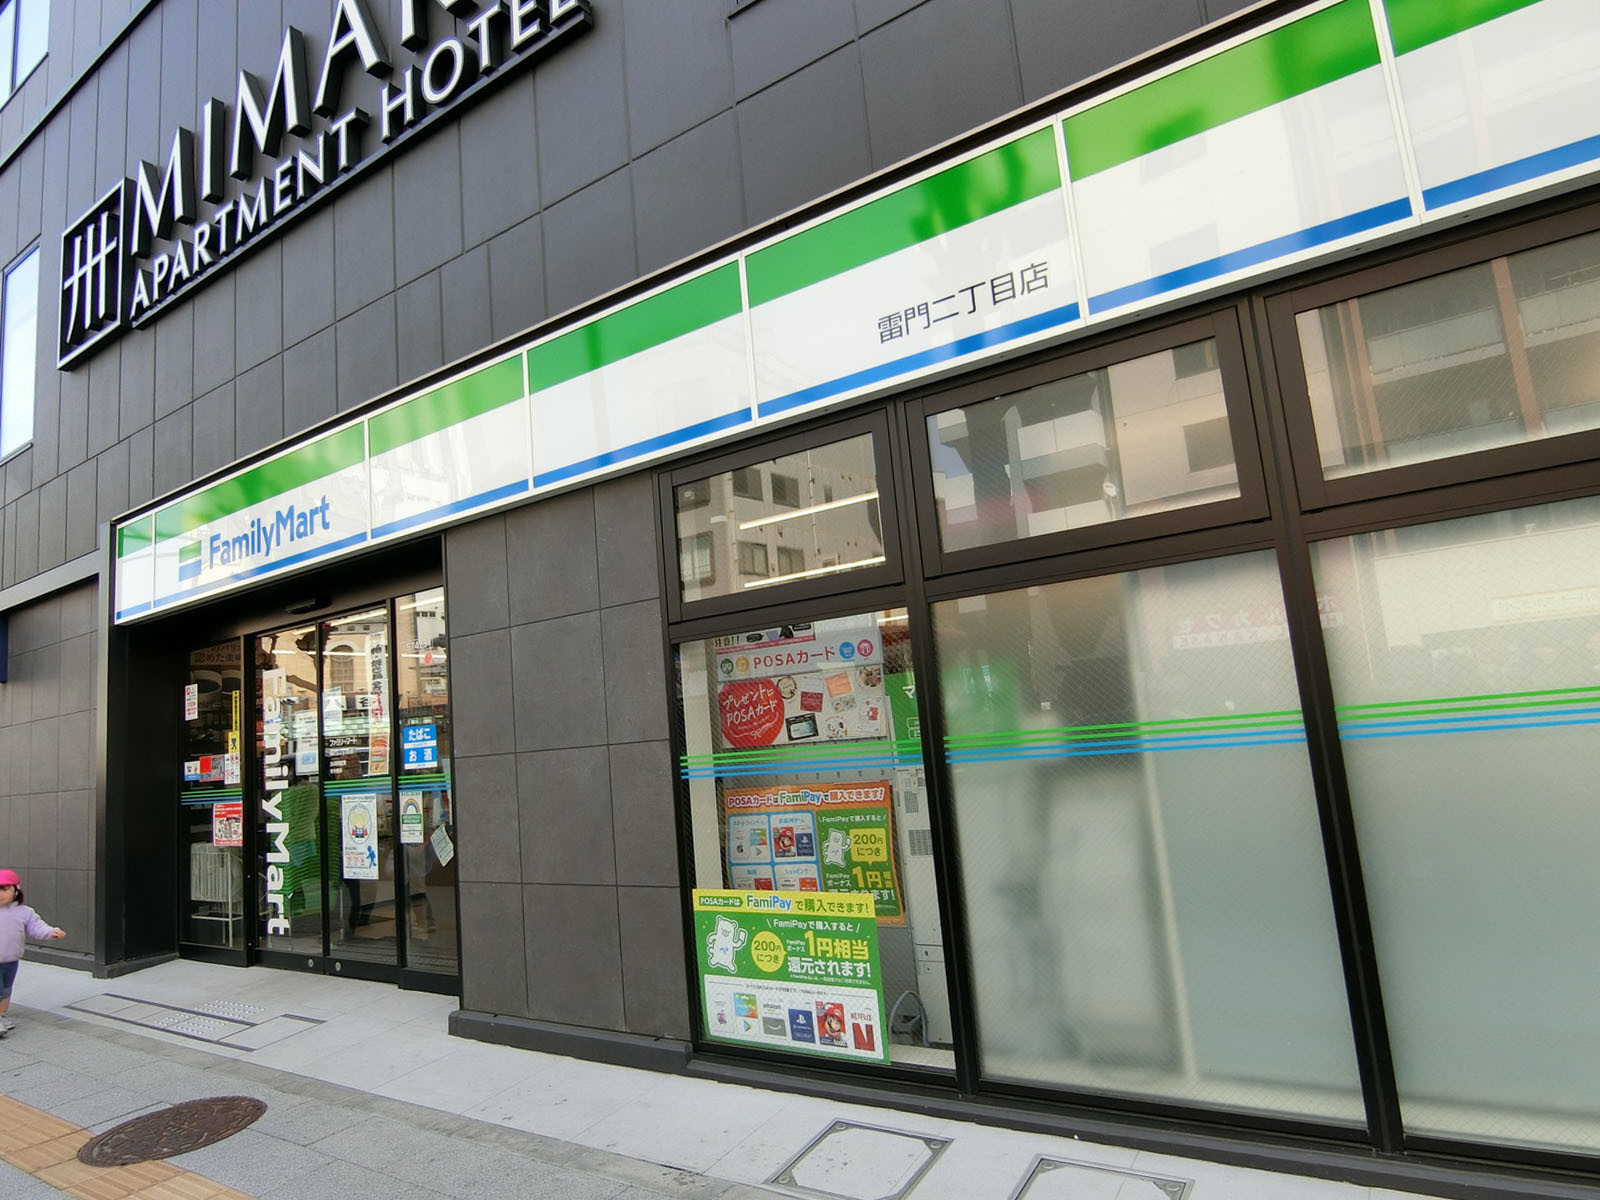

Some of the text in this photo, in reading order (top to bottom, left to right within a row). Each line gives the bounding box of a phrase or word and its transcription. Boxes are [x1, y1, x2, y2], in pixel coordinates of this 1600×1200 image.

[131, 0, 476, 258] MIMA
[129, 107, 367, 320] APARTMENT
[877, 261, 1049, 344] 雷門二丁目店
[209, 495, 330, 570] FamilyMart
[753, 646, 836, 669] POSAカード
[723, 684, 775, 711] プレゼントに
[726, 700, 778, 726] POSAカード
[408, 727, 432, 741] たばこ
[408, 748, 433, 762] お酒
[262, 667, 290, 935] FamilyMart
[852, 833, 884, 845] 200円
[856, 847, 881, 857] につき
[700, 896, 740, 906] POSAカードは
[746, 894, 792, 911] FamiPay
[773, 919, 854, 932] FamiPayで購入すると
[754, 940, 782, 952] 200円
[804, 930, 870, 960] 1円相当
[756, 954, 780, 963] につき
[787, 956, 872, 977] 還元されます!
[851, 1012, 872, 1022] NETFLIX
